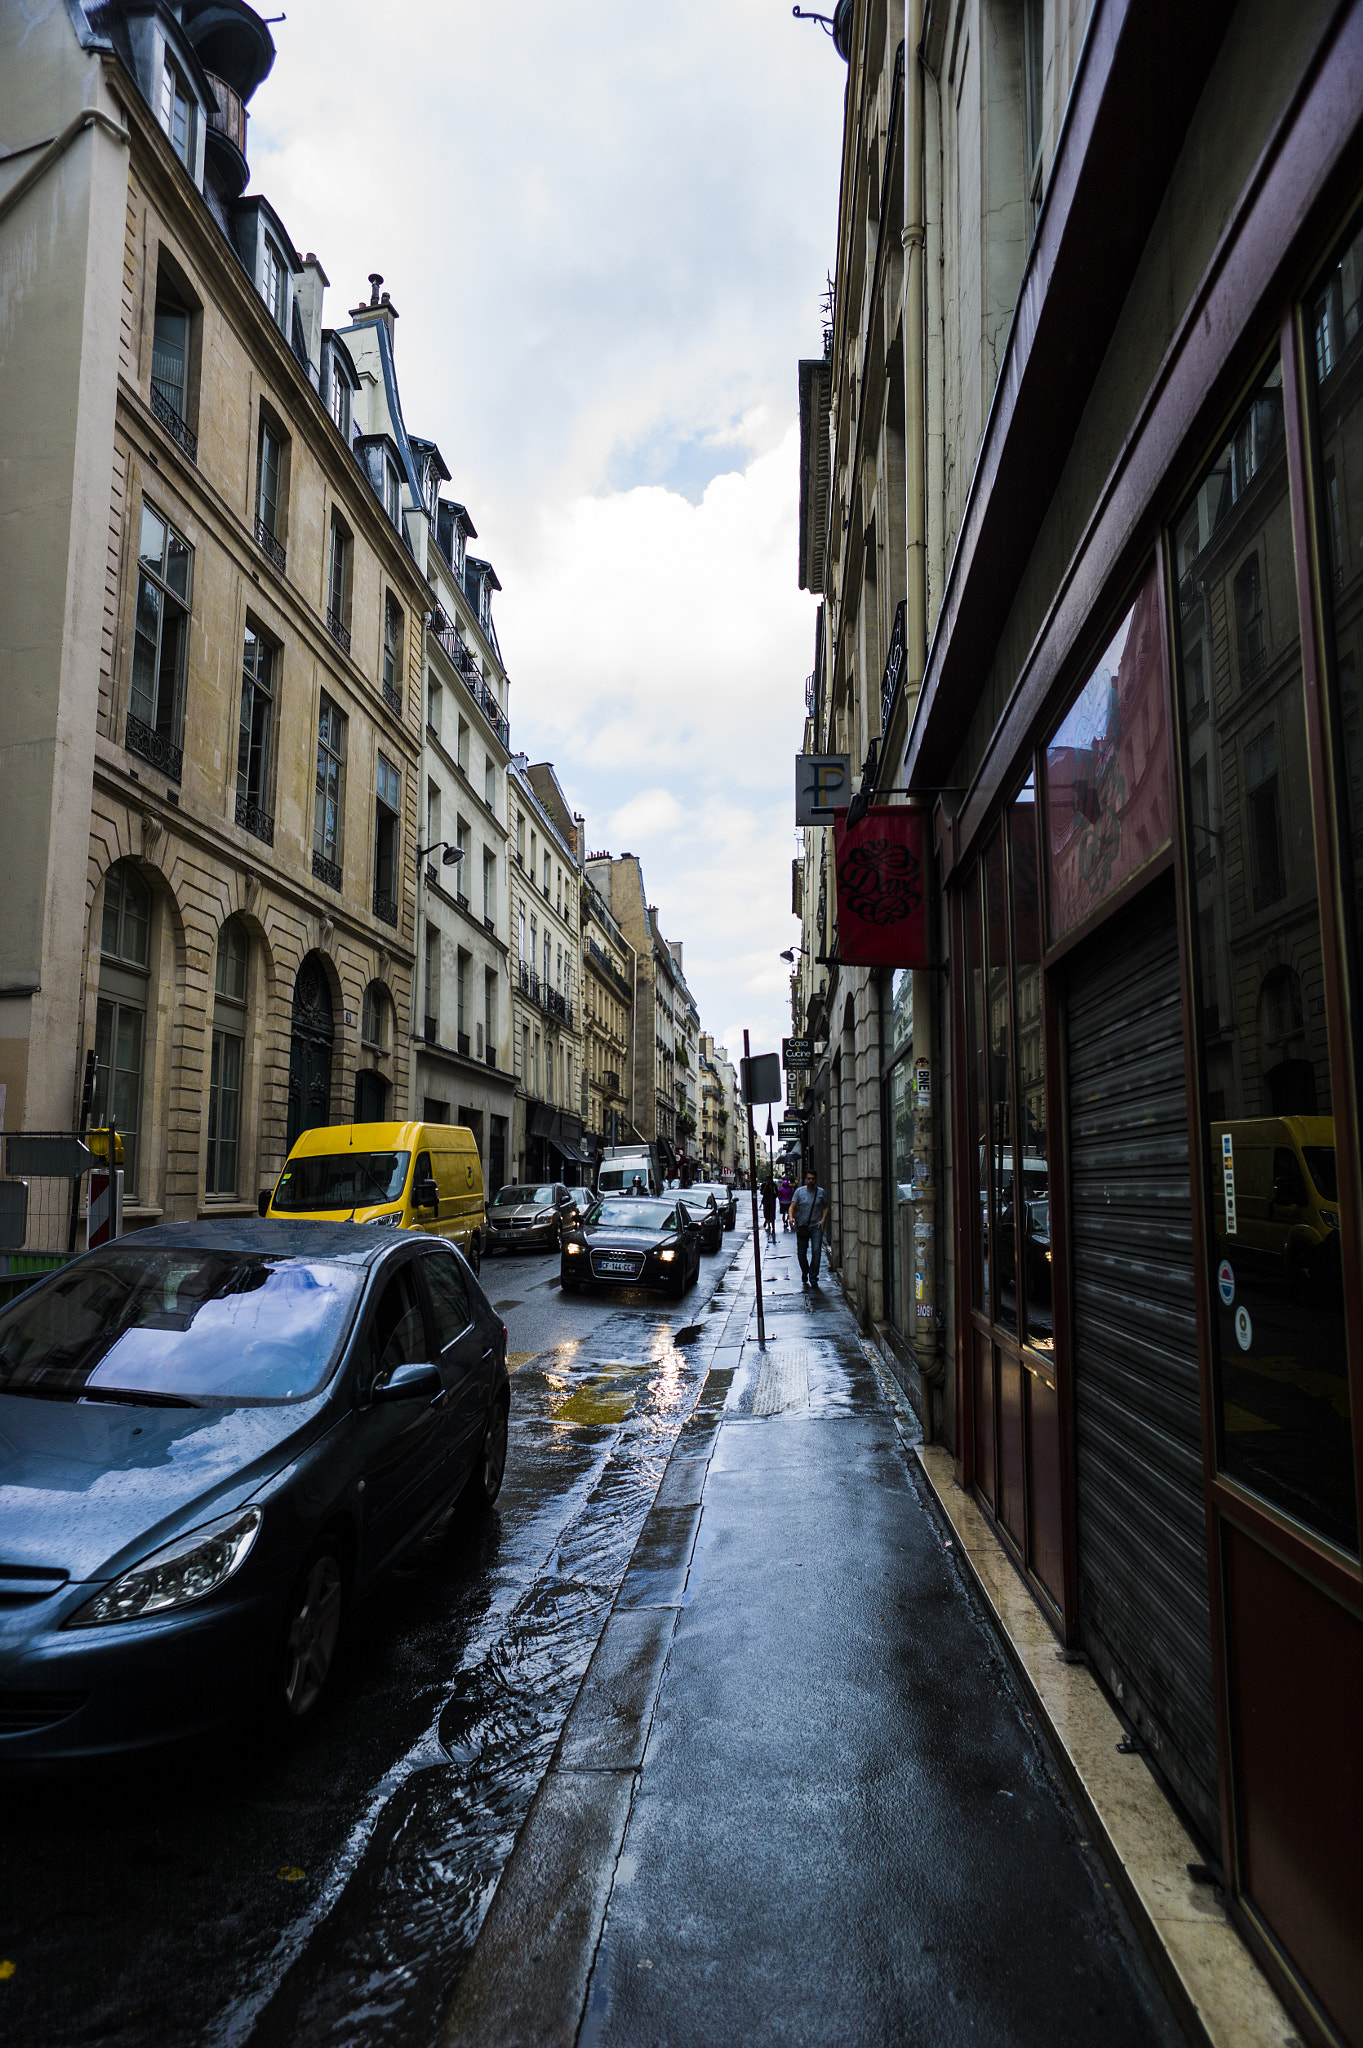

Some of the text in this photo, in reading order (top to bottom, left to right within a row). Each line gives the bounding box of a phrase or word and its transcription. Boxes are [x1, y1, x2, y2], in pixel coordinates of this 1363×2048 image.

[788, 1038, 809, 1047] Casa
[785, 1049, 811, 1058] Cucine
[788, 1069, 797, 1105] OTEL
[918, 1071, 930, 1091] BNE
